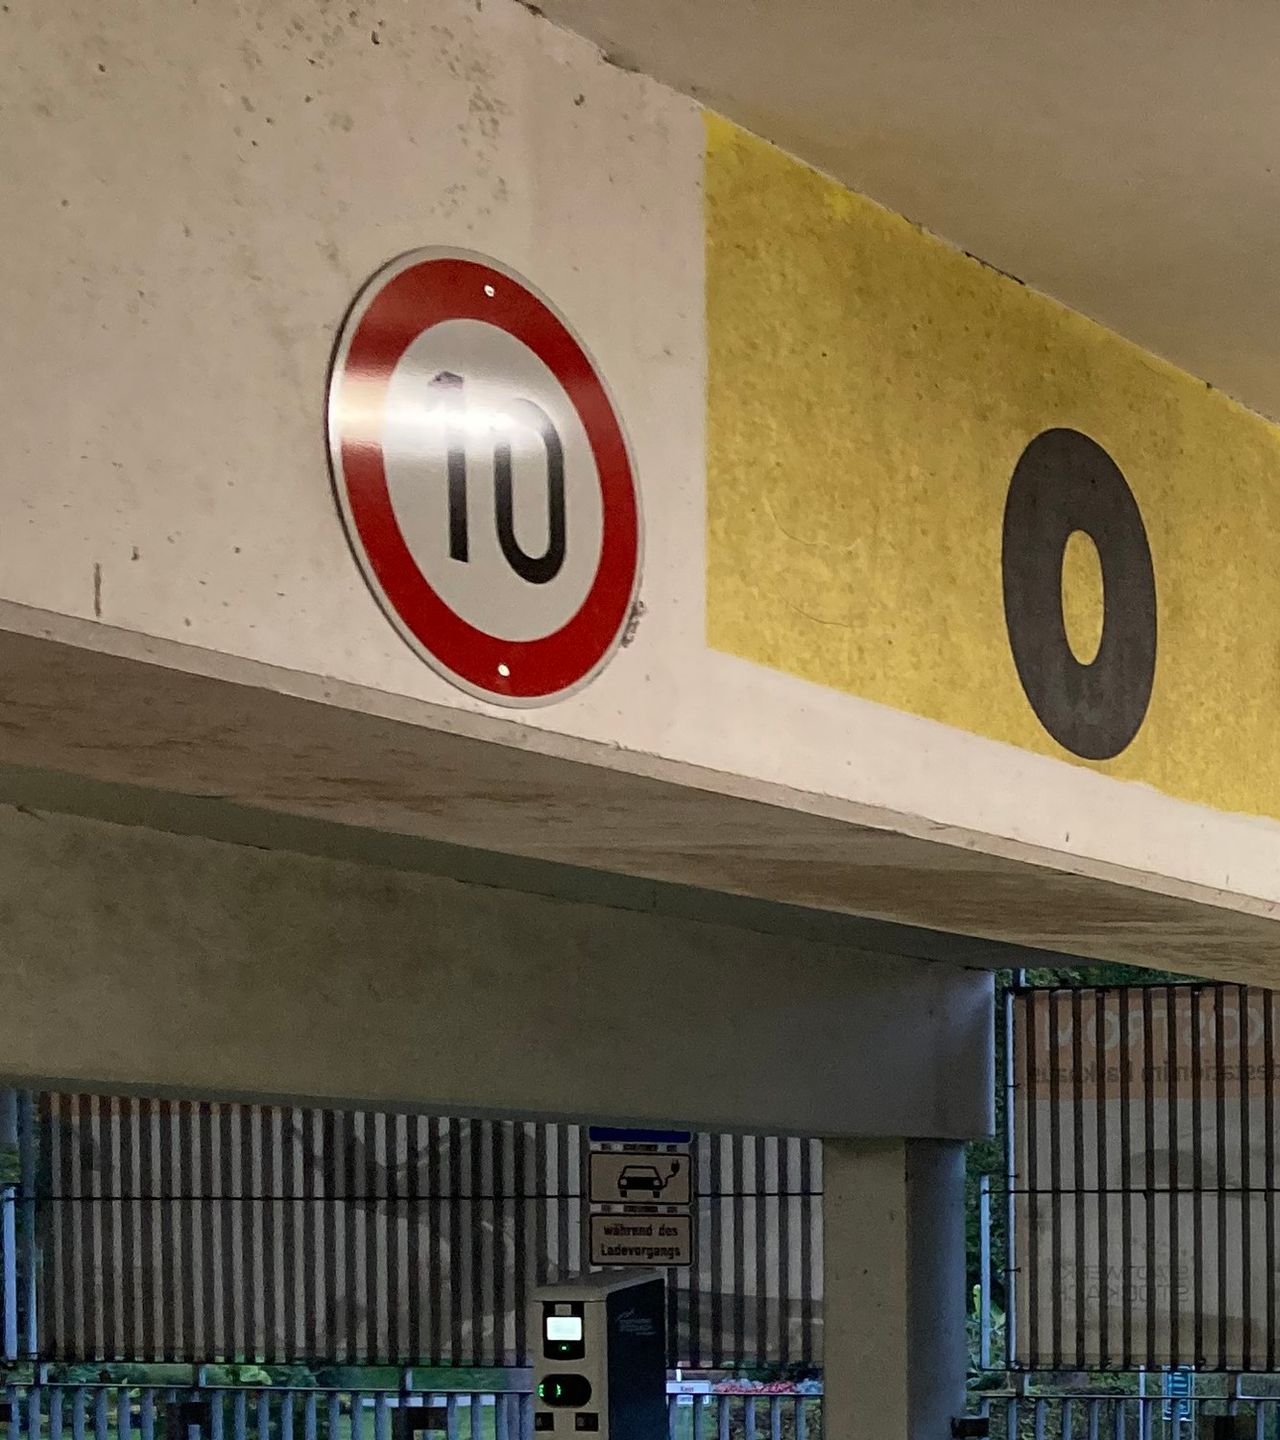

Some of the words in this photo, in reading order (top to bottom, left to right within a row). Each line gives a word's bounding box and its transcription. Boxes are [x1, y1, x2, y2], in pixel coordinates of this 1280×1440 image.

[425, 369, 568, 586] 10
[603, 1223, 653, 1237] während
[658, 1224, 678, 1236] des
[601, 1244, 681, 1259] Ladevorgangs
